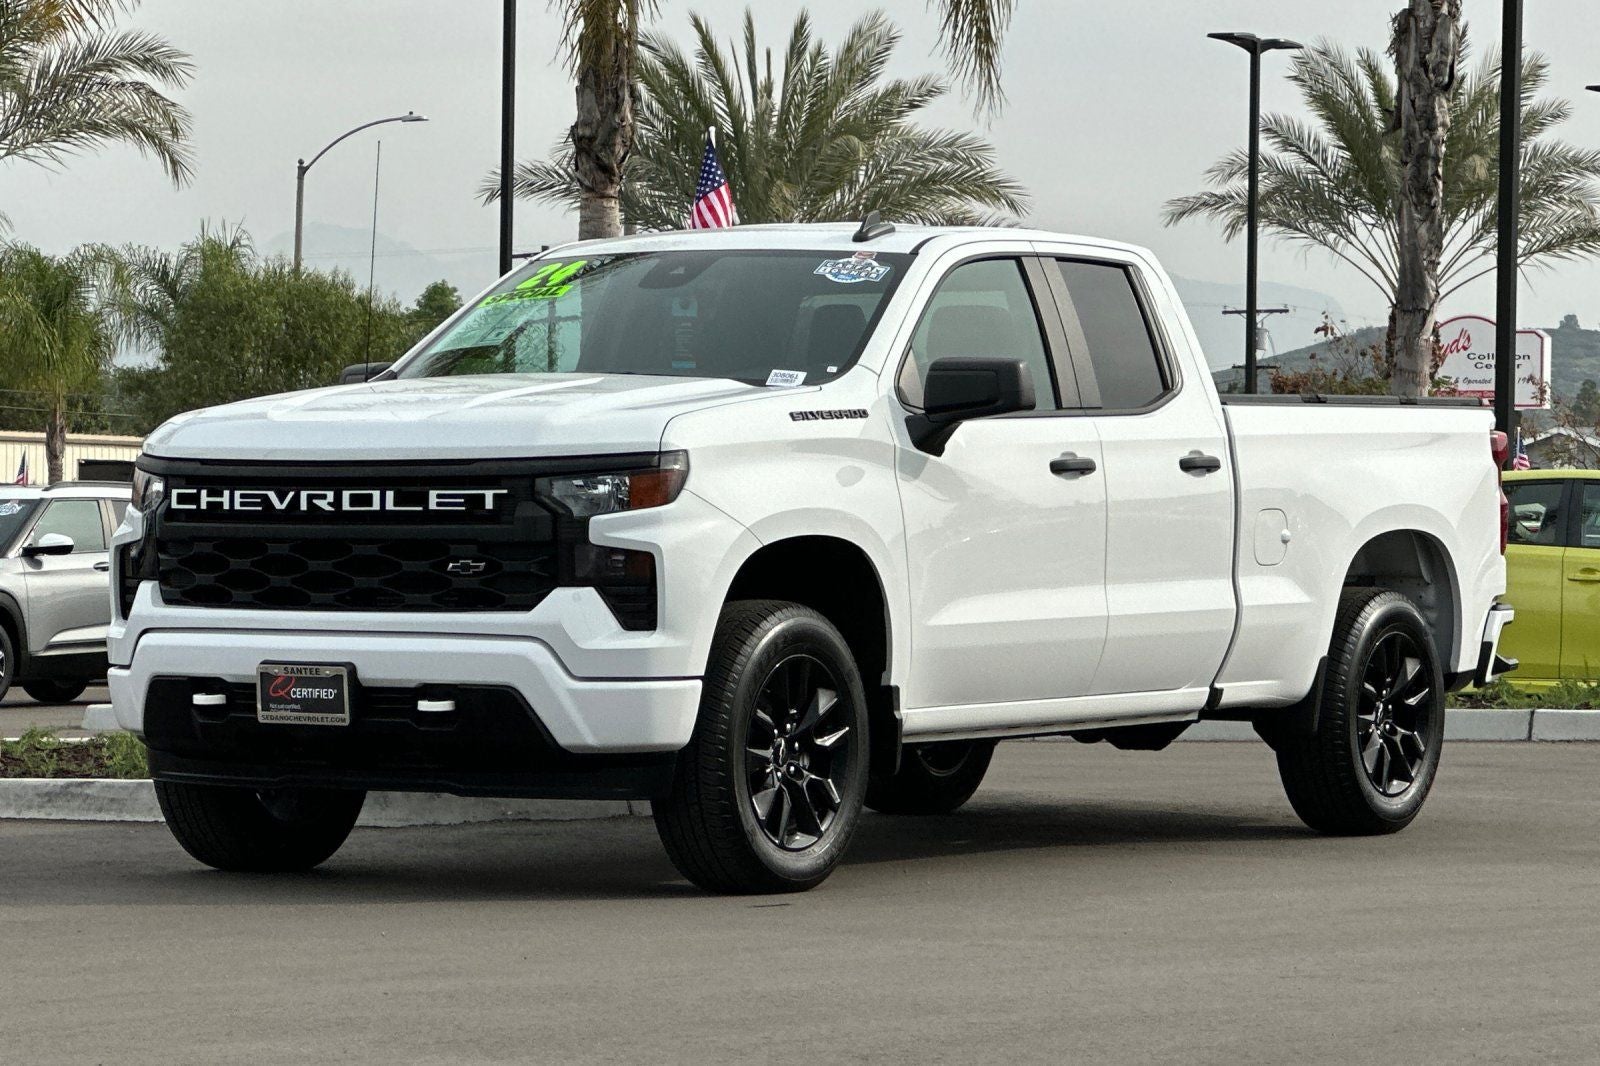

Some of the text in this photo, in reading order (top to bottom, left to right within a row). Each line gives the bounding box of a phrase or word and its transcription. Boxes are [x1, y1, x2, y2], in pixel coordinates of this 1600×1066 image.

[826, 262, 886, 274] CARFAX
[1467, 352, 1531, 361] Collon
[789, 409, 869, 421] SILVERADO
[171, 489, 508, 511] CHEVROLET
[283, 666, 321, 676] SANTEE
[290, 688, 335, 700] CERTIFIED
[261, 714, 346, 723] SEDANOCHEVROLET.COM
